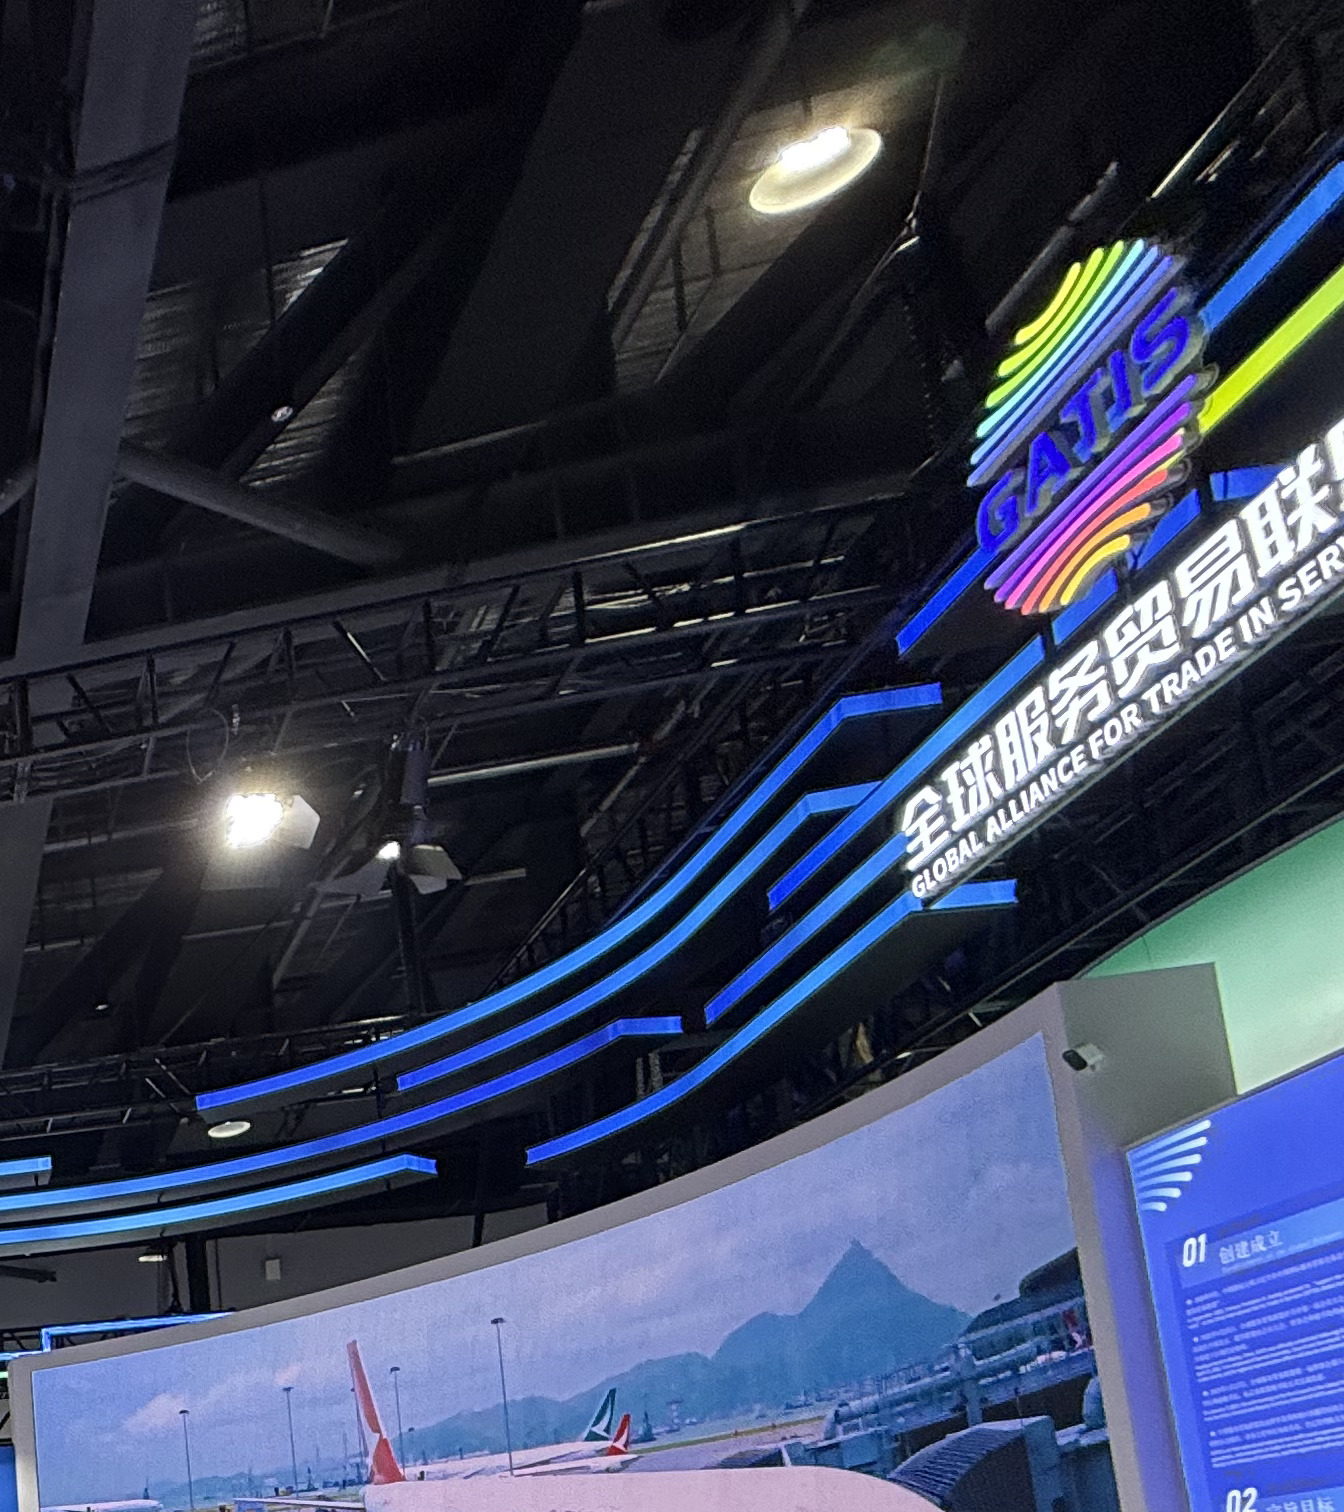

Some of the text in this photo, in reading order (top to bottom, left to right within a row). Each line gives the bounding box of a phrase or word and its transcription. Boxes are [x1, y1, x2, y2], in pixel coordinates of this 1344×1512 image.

[977, 287, 1191, 554] GATIS
[912, 831, 984, 898] GLOBAL
[986, 745, 1088, 843] ALLIANCE
[1089, 706, 1141, 757] FOR
[1142, 625, 1236, 709] TRADE
[1240, 596, 1274, 644] IN
[1182, 1233, 1207, 1268] 01
